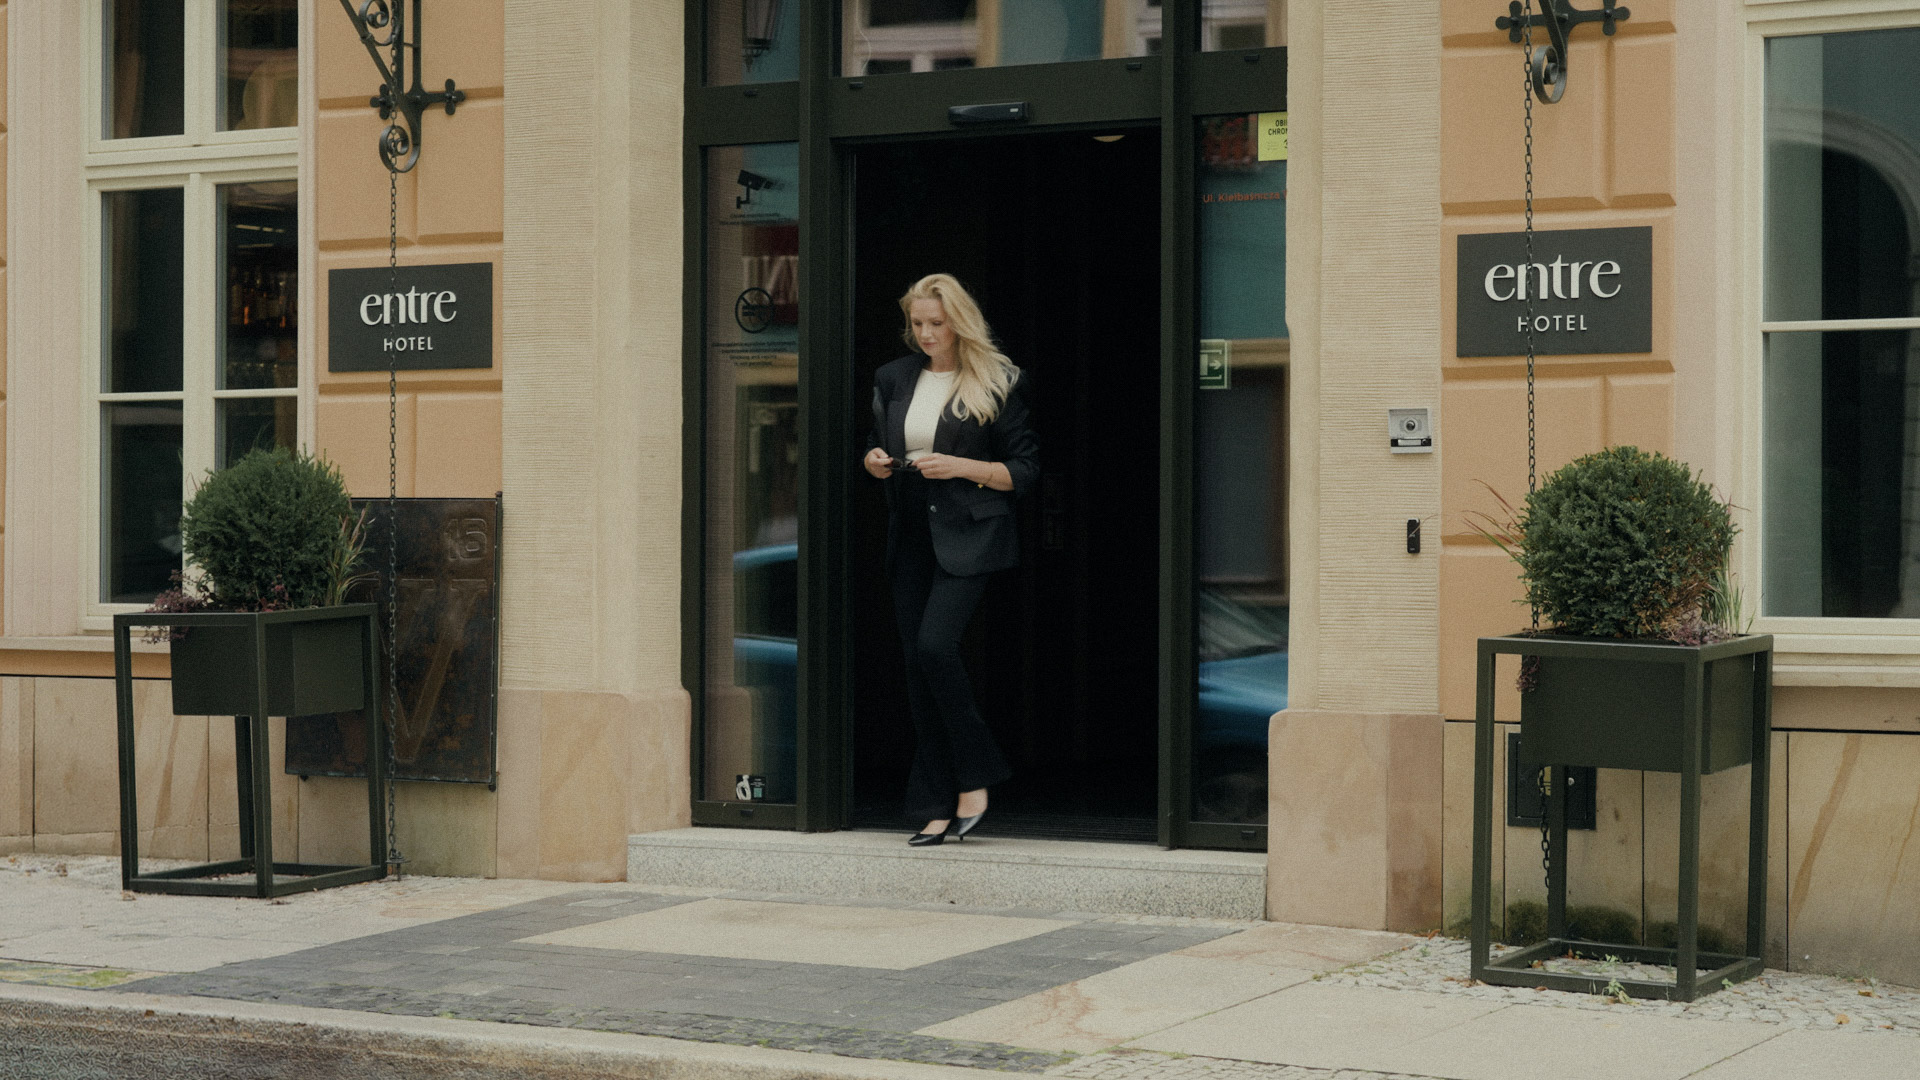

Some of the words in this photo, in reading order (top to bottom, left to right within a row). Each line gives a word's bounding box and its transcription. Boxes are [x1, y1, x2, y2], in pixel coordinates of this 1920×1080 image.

[1203, 194, 1215, 203] Ul.
[1484, 254, 1622, 302] entre
[360, 285, 457, 326] entre
[1517, 314, 1588, 333] HOTEL
[383, 336, 434, 352] HOTEL
